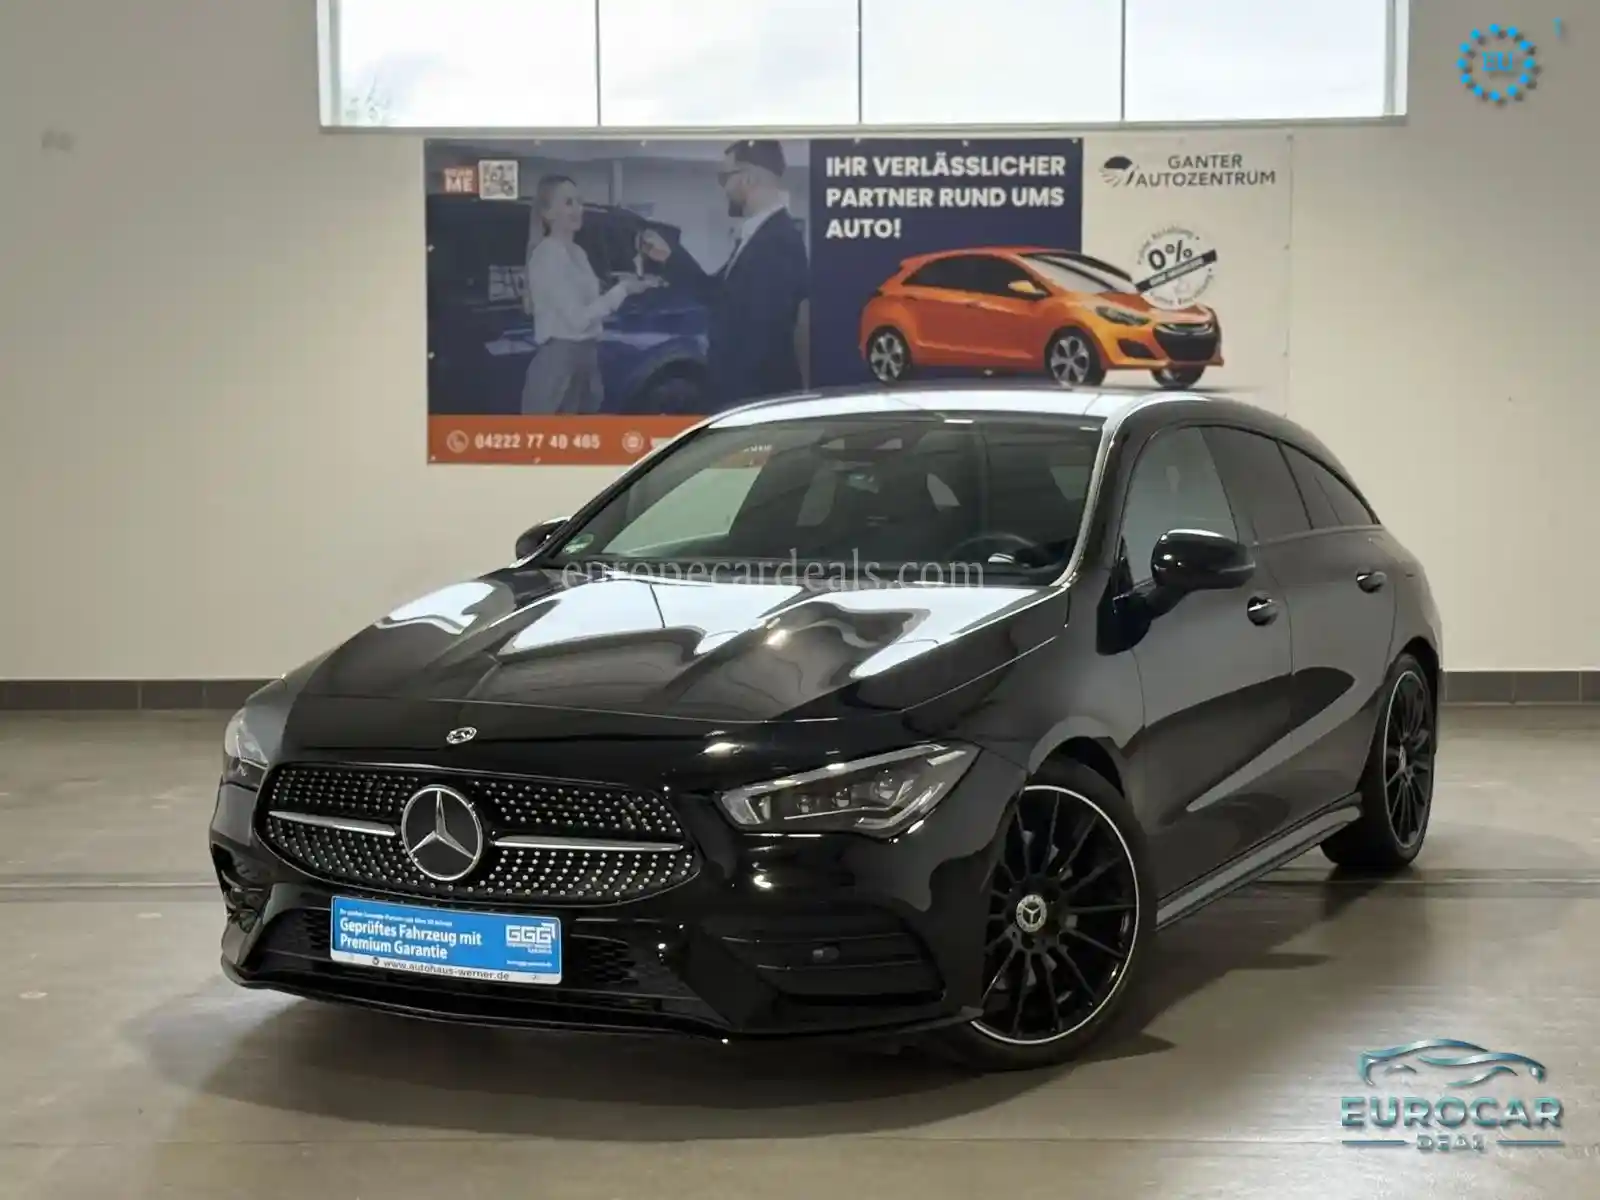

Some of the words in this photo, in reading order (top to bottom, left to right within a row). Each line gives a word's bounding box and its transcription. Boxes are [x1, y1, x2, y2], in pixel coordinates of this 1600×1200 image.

[826, 156, 867, 177] IHR
[873, 152, 1066, 177] VERLÄSSLICHER
[1168, 154, 1243, 169] GANTER
[1135, 170, 1276, 187] AUTOZENTRUM
[826, 187, 933, 208] PARTNER
[939, 187, 1007, 208] RUND
[1012, 187, 1065, 207] UMS
[826, 218, 902, 239] AUTO!
[1148, 240, 1193, 271] 0%
[526, 433, 545, 449] 77
[340, 917, 397, 938] Geprüftes
[399, 924, 457, 947] Fahrzeug
[460, 931, 482, 945] mit
[340, 933, 392, 953] Premium
[394, 940, 448, 959] Garantie
[383, 960, 510, 980] www.autohaus-werner.de
